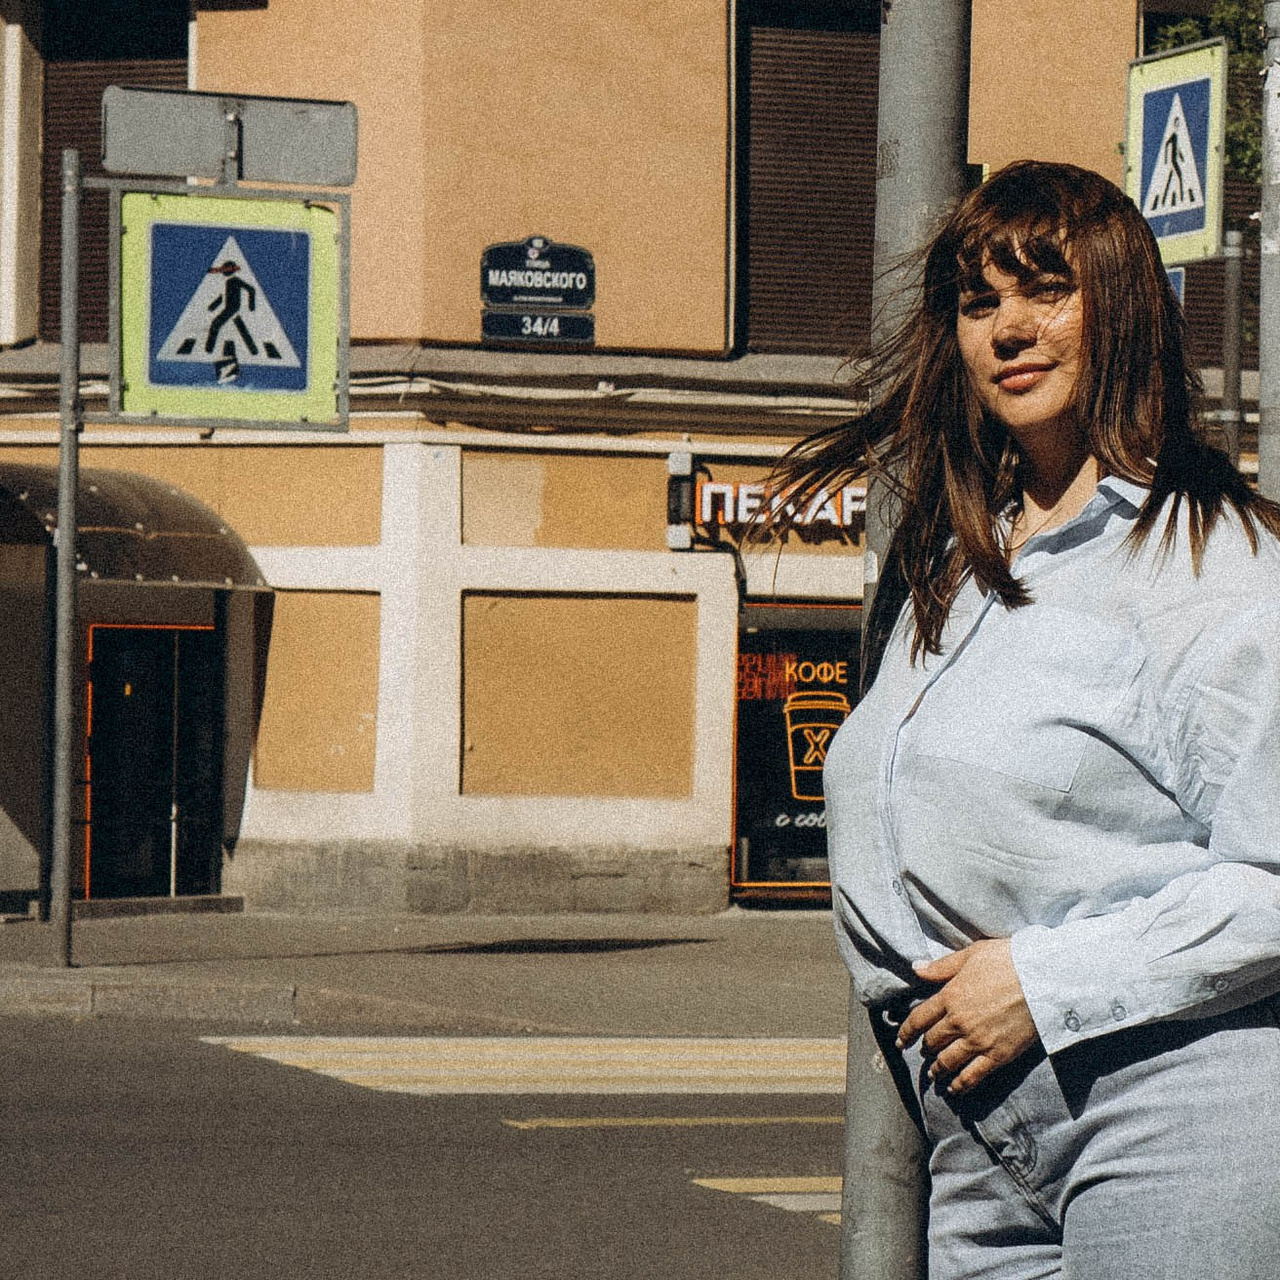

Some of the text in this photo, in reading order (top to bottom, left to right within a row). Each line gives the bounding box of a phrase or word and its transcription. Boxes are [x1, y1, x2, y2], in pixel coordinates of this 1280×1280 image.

[488, 269, 587, 290] МАЯКОВСКОГО
[521, 315, 560, 337] 34/4
[784, 660, 848, 684] КОФЕ
